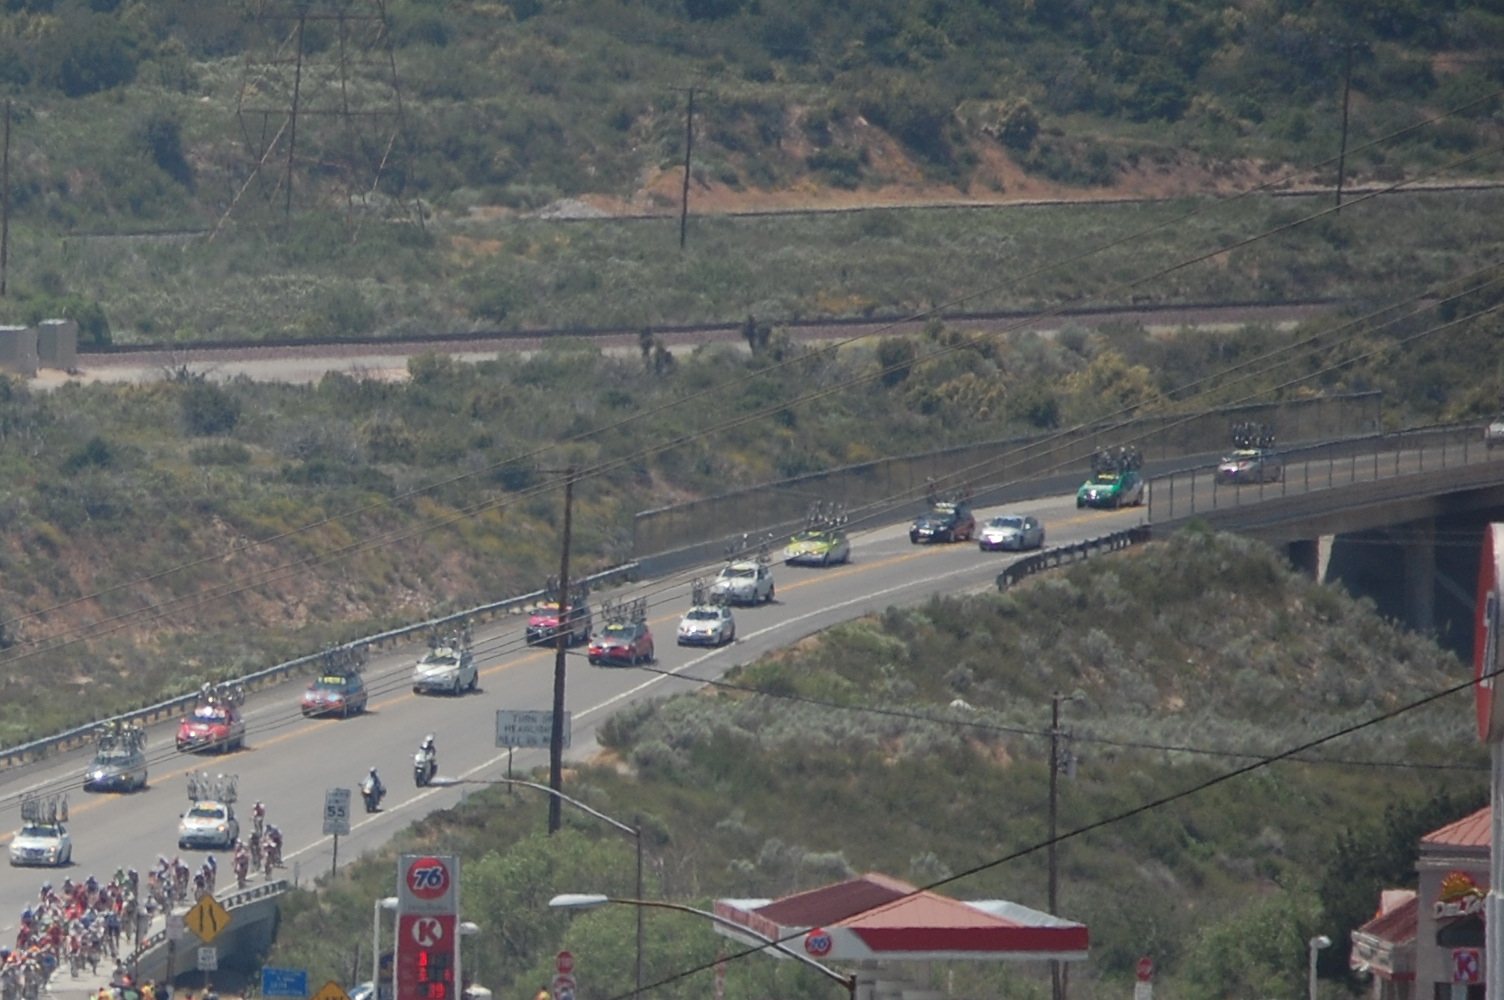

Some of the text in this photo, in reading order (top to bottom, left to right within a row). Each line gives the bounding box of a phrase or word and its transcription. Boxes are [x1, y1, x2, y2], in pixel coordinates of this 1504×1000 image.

[327, 805, 345, 817] 55
[413, 866, 443, 889] 76
[808, 936, 829, 952] 76
